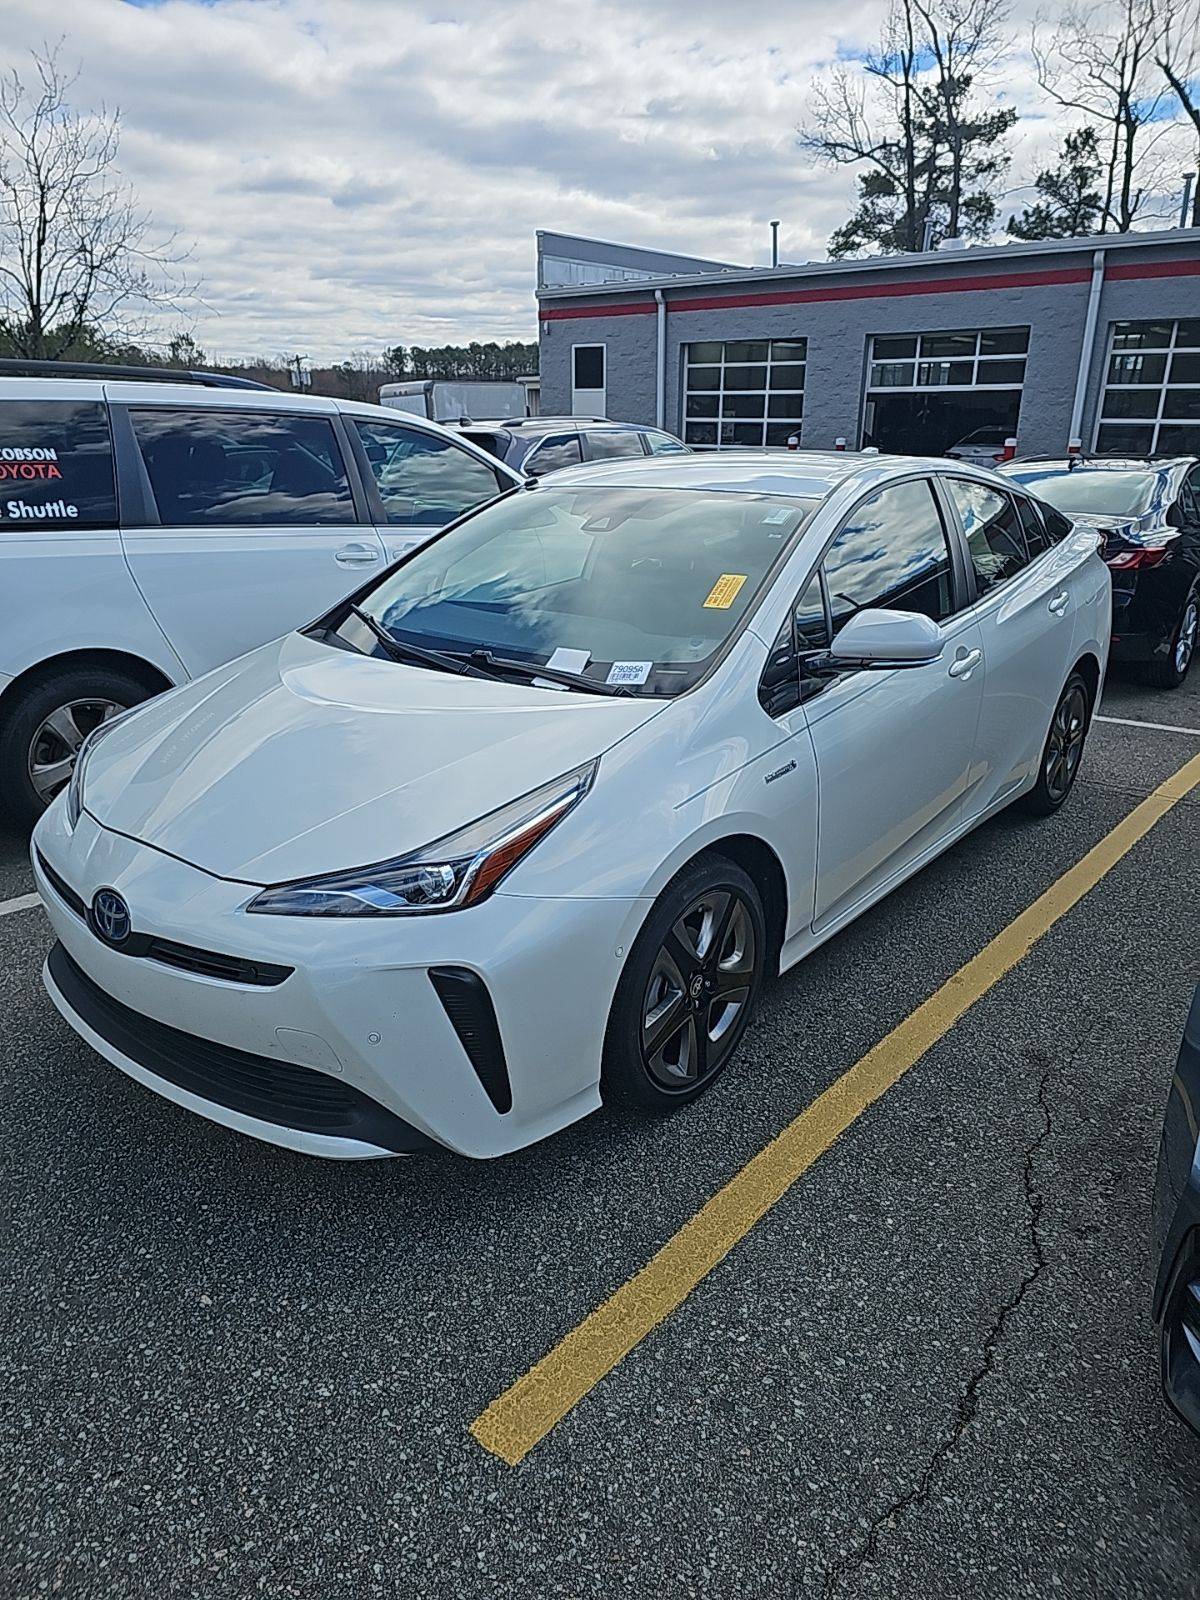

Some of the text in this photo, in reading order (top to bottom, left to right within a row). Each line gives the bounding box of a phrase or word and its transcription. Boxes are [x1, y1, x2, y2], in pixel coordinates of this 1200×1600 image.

[0, 448, 57, 461] OBSON
[7, 499, 78, 518] Shuttle
[613, 665, 644, 673] 79095A
